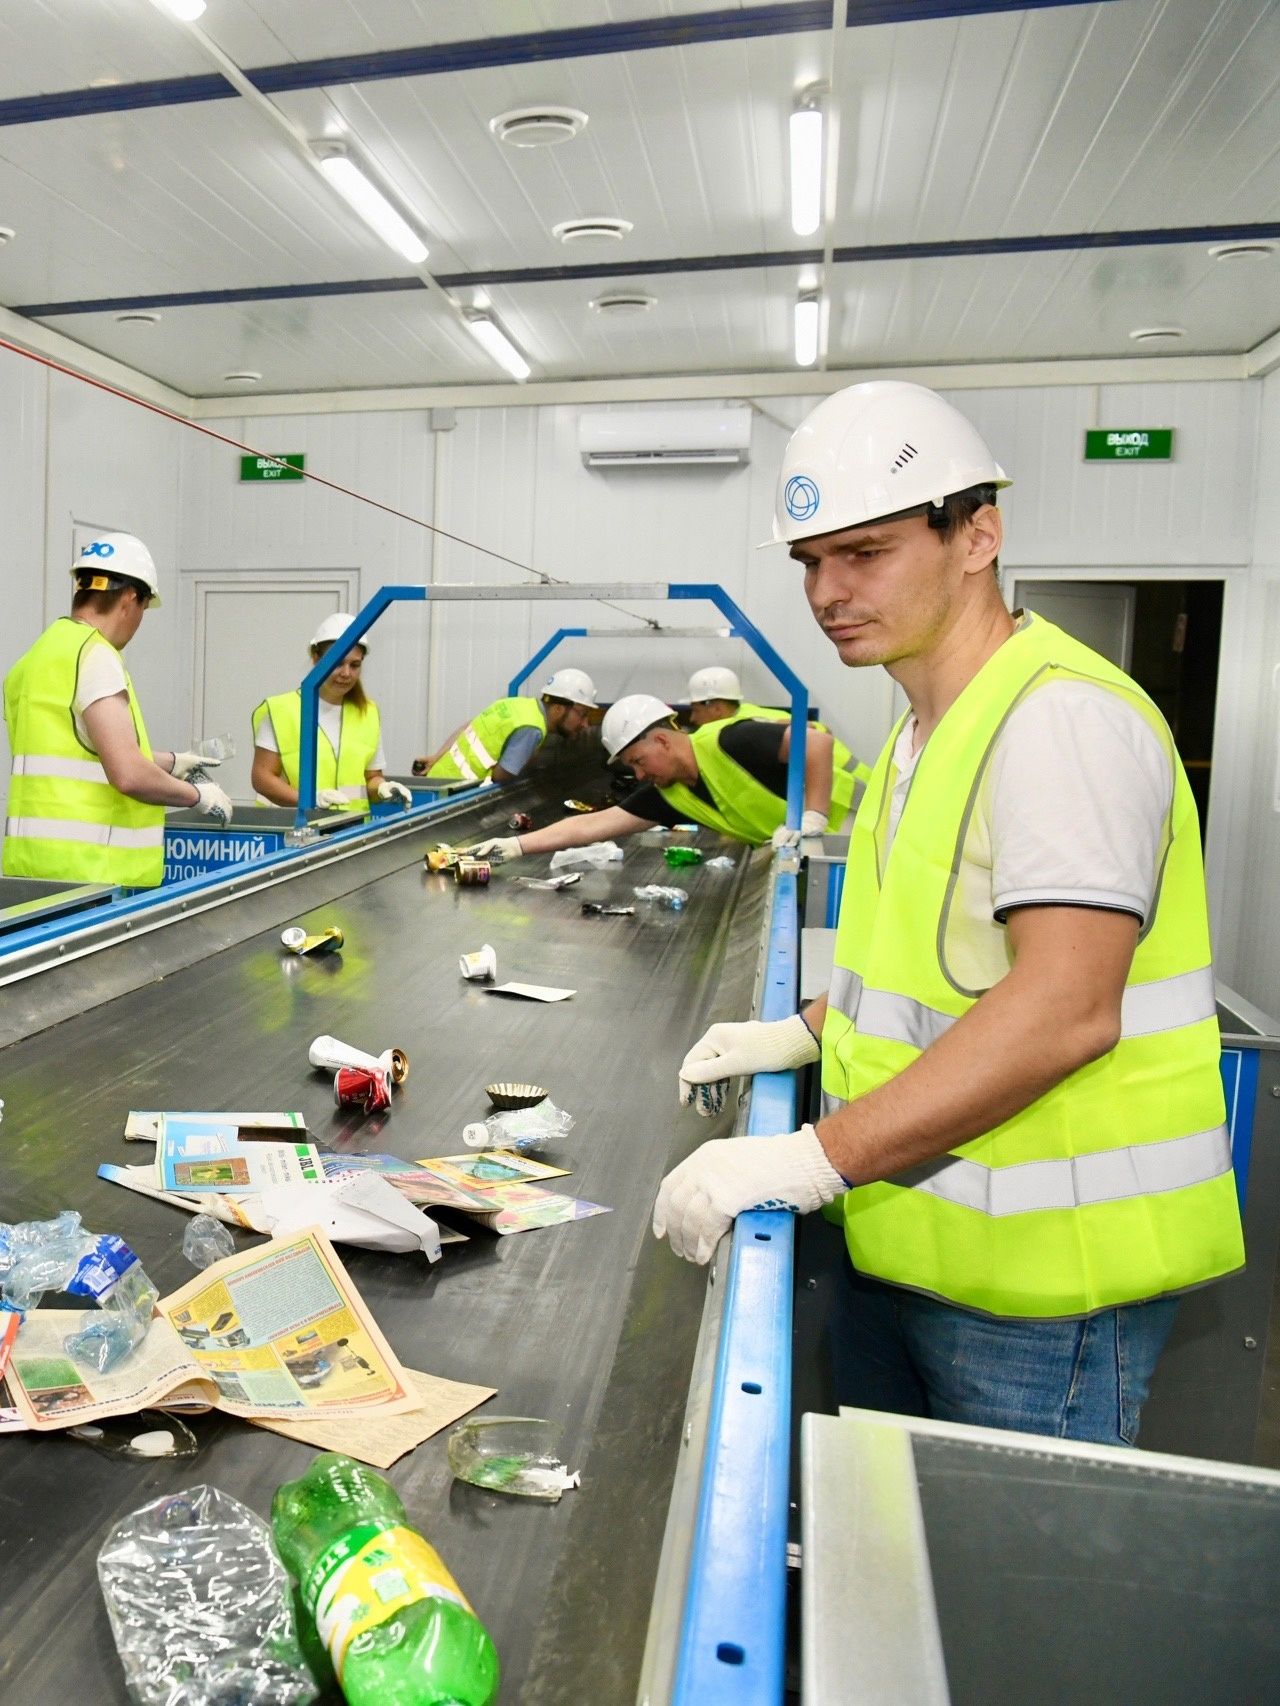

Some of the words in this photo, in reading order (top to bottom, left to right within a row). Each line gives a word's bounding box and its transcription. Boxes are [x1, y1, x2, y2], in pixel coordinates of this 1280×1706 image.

[1115, 447, 1141, 456] EXIT
[262, 469, 282, 478] EXIT
[298, 1157, 314, 1171] JBL
